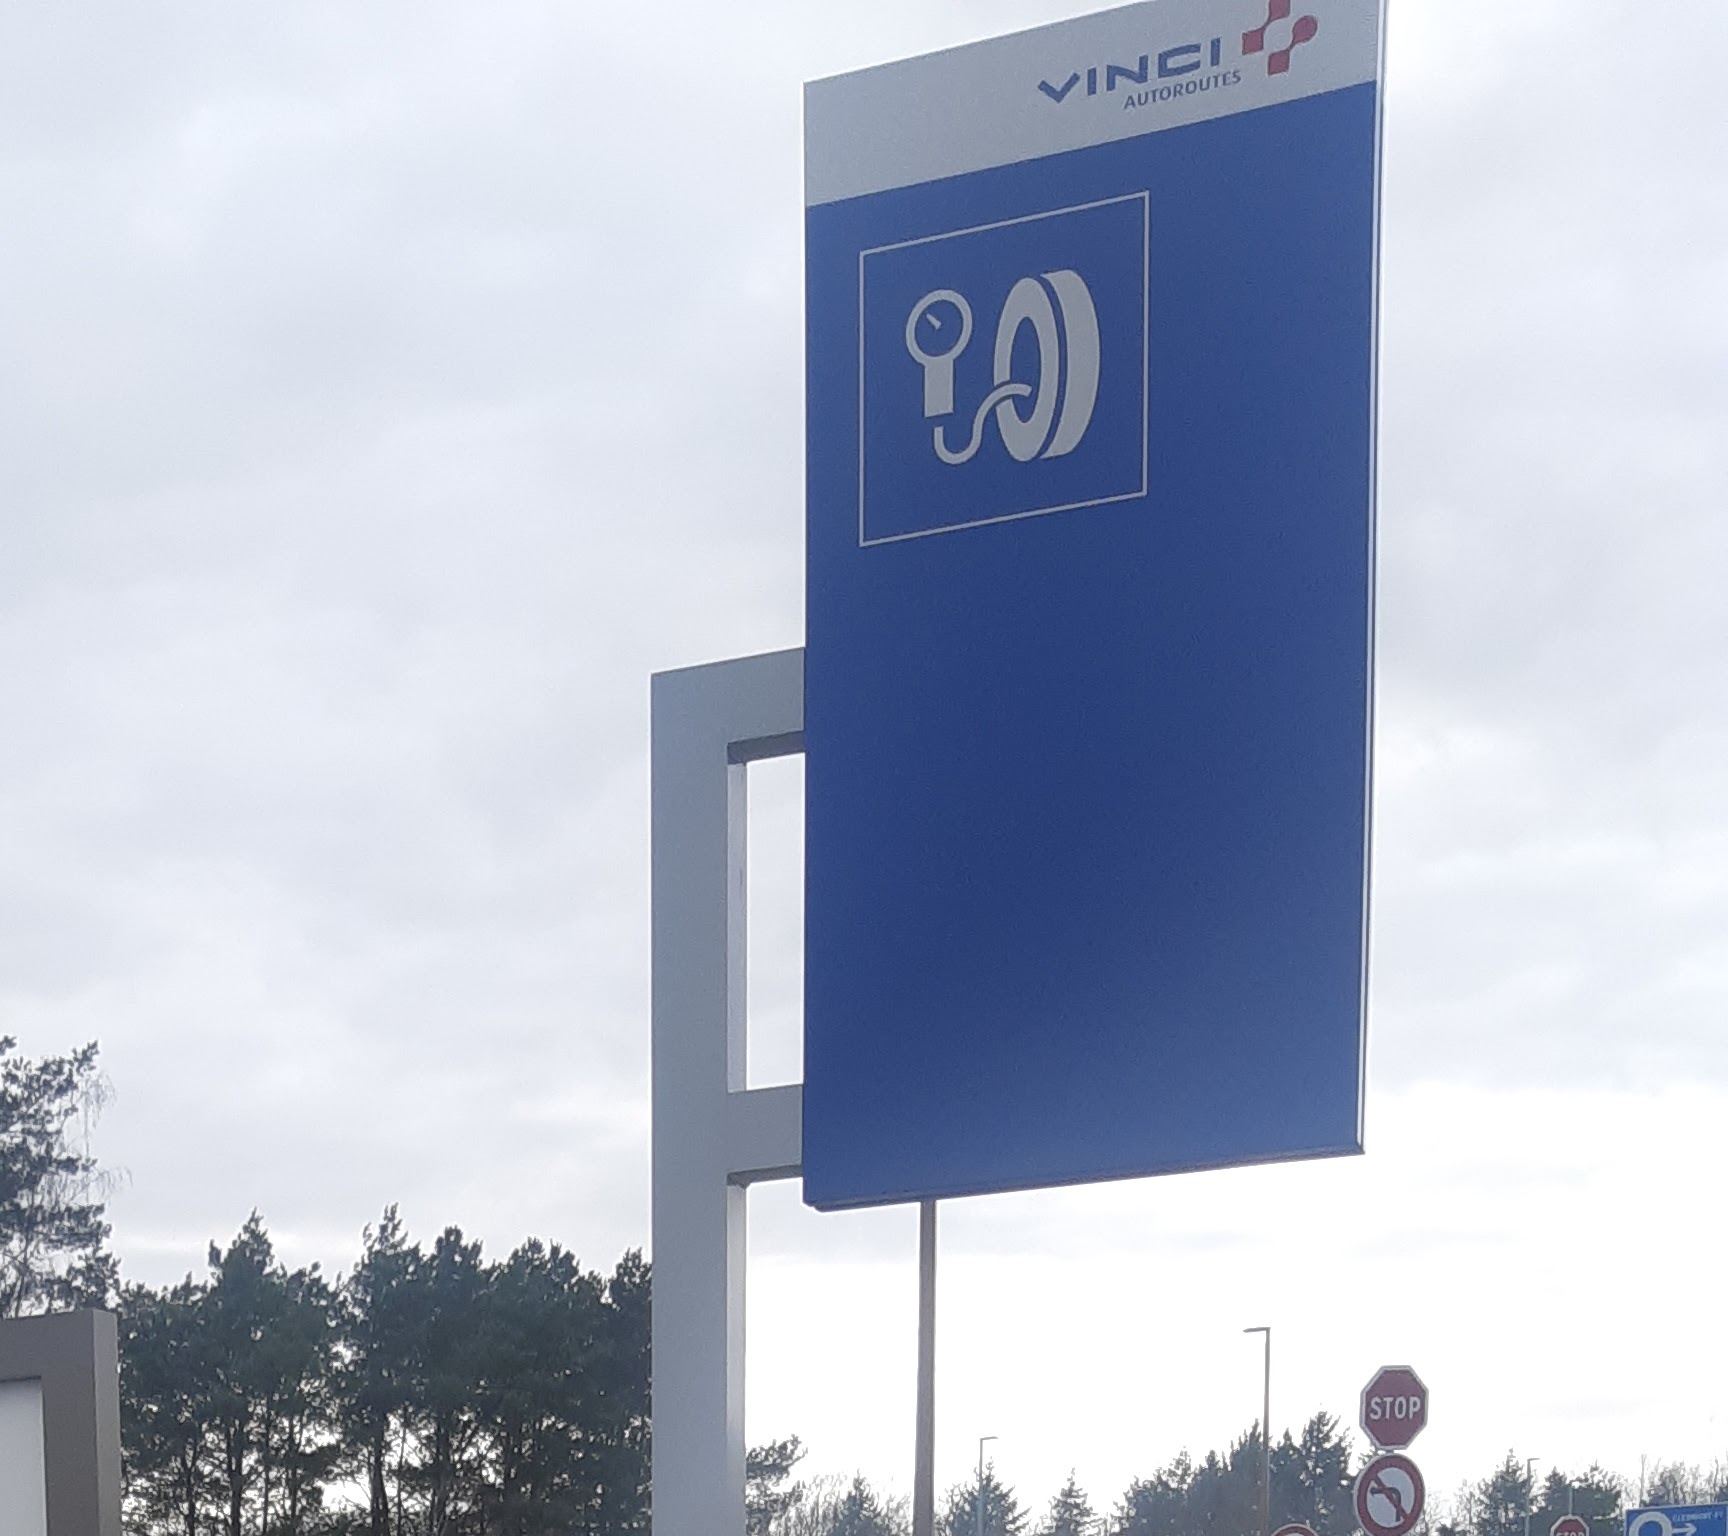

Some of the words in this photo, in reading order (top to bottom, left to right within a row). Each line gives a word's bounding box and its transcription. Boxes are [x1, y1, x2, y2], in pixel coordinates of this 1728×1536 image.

[1037, 37, 1221, 104] VINCI
[1123, 69, 1242, 110] AUTOROUTES
[1369, 1396, 1421, 1420] STOP
